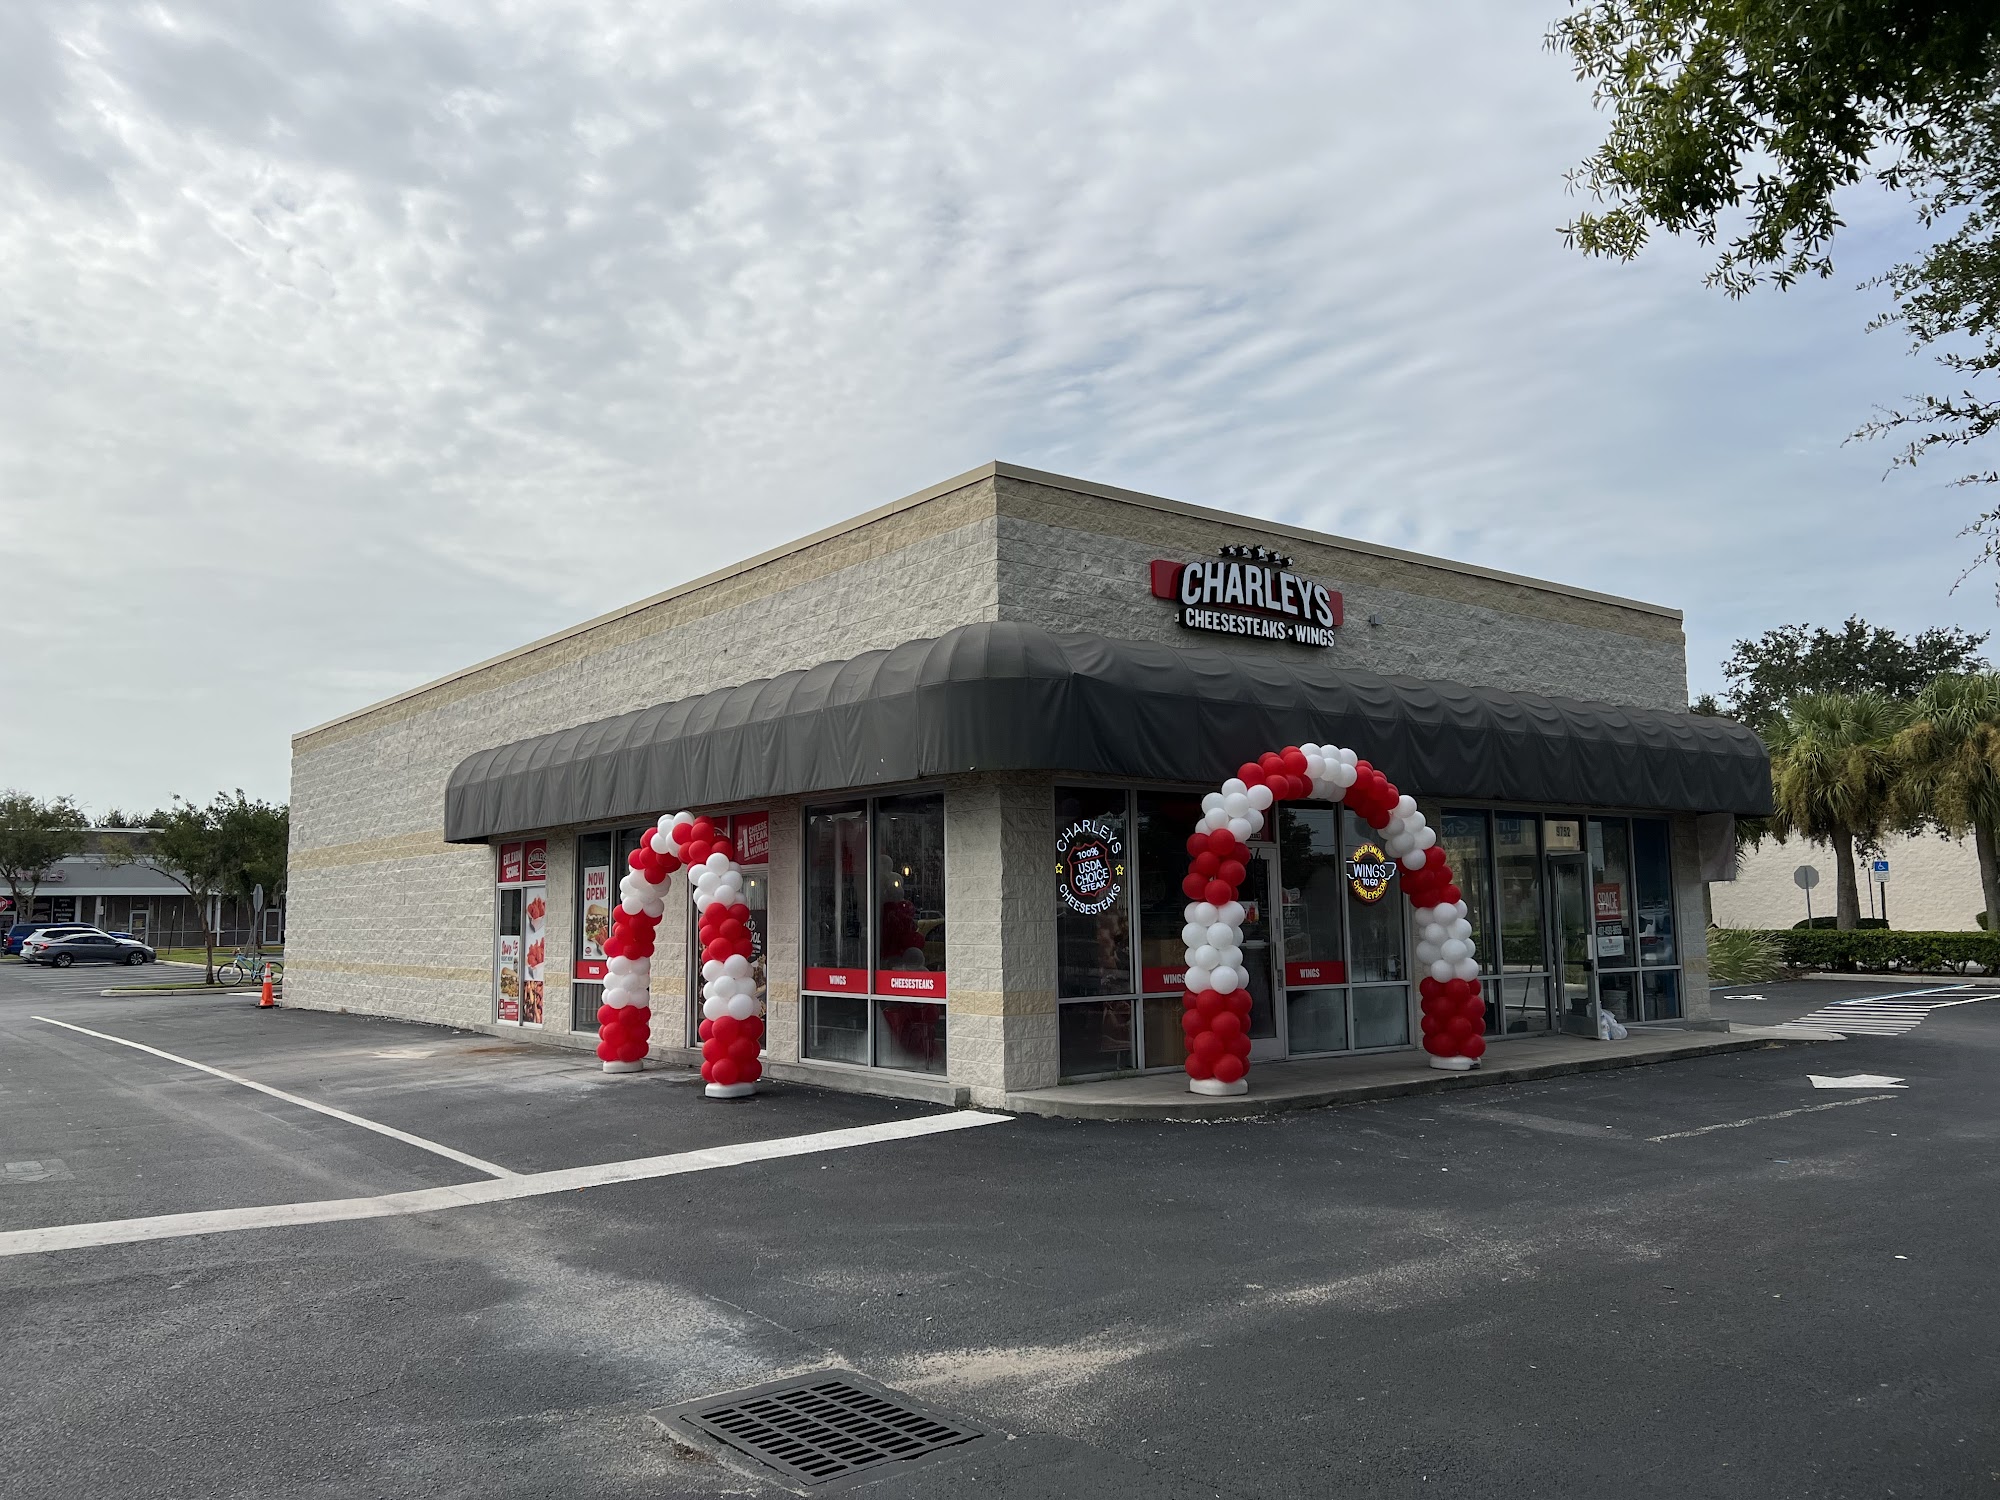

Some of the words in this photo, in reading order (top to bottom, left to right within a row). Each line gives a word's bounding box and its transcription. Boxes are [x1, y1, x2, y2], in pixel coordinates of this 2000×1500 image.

[1181, 562, 1334, 627] CHARLEYS
[1185, 607, 1286, 640] CHEESESTEAKS
[1295, 624, 1335, 647] WINGS
[748, 821, 767, 834] CHEESE
[749, 829, 768, 844] STEAK
[1057, 820, 1122, 854] CHARLEYS
[750, 842, 769, 856] WORLD
[1076, 847, 1099, 859] 100%
[1353, 845, 1368, 861] ORDER
[1369, 845, 1386, 863] ONLINE
[1078, 859, 1102, 874] USDA
[1353, 863, 1386, 878] WINGS
[588, 871, 605, 886] NOW
[1075, 868, 1109, 886] CHOICE
[1362, 878, 1369, 886] TO
[1370, 878, 1378, 886] GO
[586, 887, 607, 901] OPEN!
[1081, 880, 1106, 893] STEAK
[1059, 883, 1121, 915] CHEESESTEAKS
[1597, 892, 1618, 910] SPACE
[829, 974, 847, 985] WINGS
[1163, 973, 1185, 984] WINGS
[1300, 968, 1320, 979] WINGS
[890, 977, 934, 990] CHEESESTEAKS
